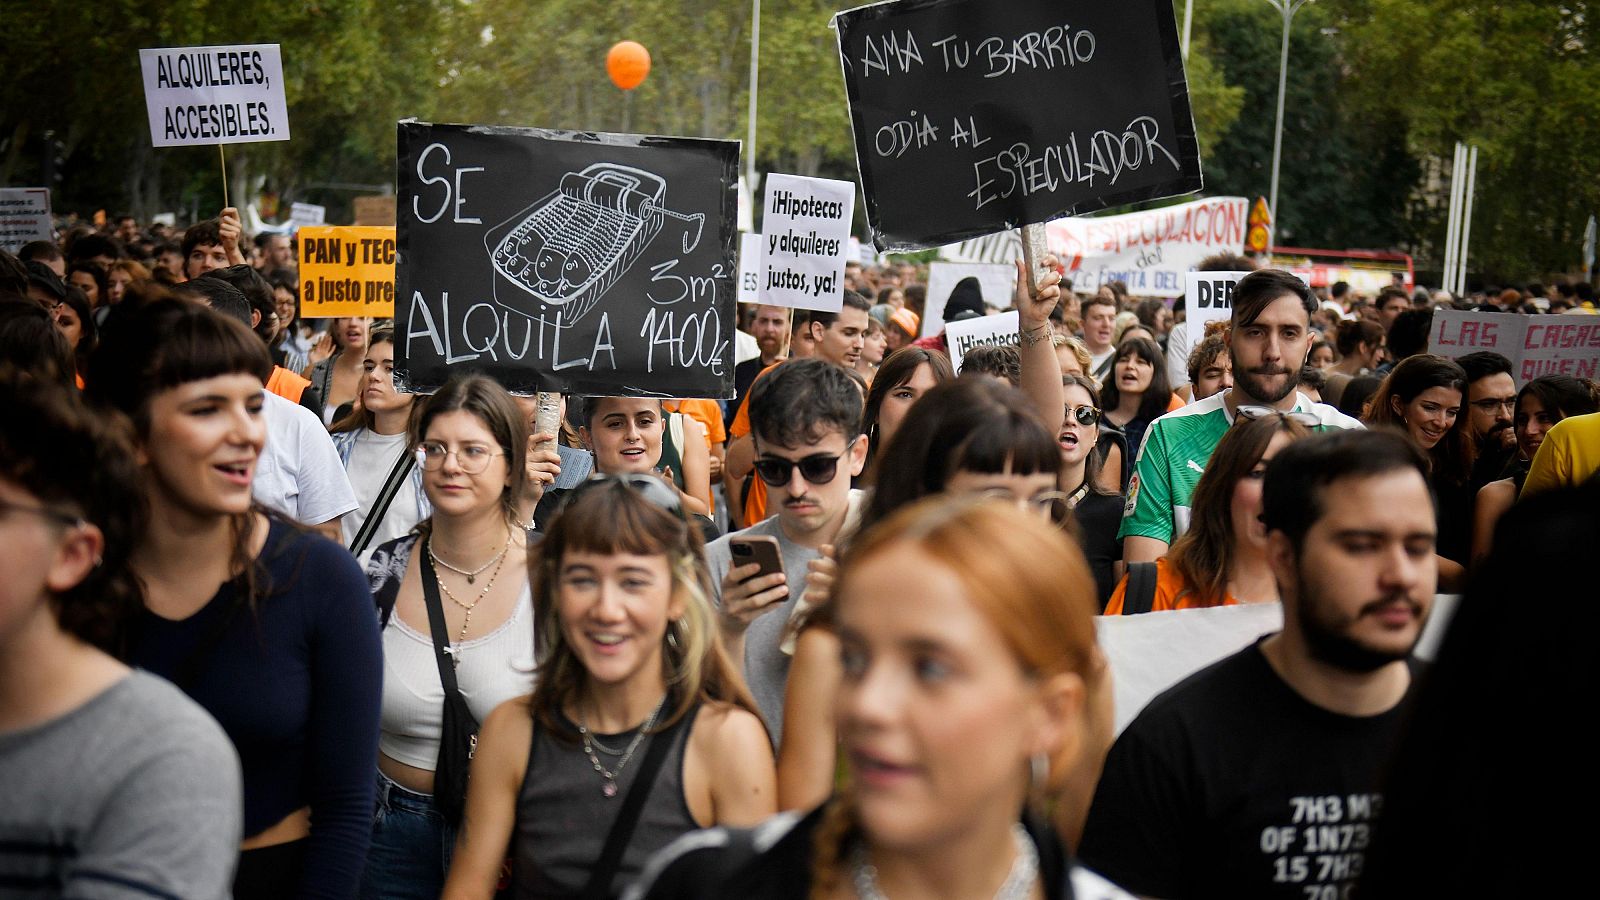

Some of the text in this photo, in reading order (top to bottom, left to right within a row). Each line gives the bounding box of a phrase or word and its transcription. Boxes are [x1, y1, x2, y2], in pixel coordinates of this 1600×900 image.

[861, 24, 1096, 78] AMA TU BARRIO
[157, 51, 270, 90] ALQUILERES,
[164, 101, 275, 140] ACCESIBLES.
[875, 110, 992, 159] ODIA AL
[967, 115, 1181, 210] ESPECULADOR
[413, 142, 485, 224] SE
[772, 190, 843, 220] ¡Hipotecas
[304, 238, 396, 267] PAN y TEC
[769, 229, 840, 258] y alquileres
[1135, 247, 1163, 268] del
[304, 276, 394, 305] a justo pre
[743, 272, 759, 291] ES
[766, 264, 837, 297] justos, ya!
[1154, 270, 1180, 290] DEL
[406, 290, 729, 376] ALQUILA 1400€
[1438, 320, 1600, 350] LAS CASAS
[1289, 796, 1343, 823] 7H3
